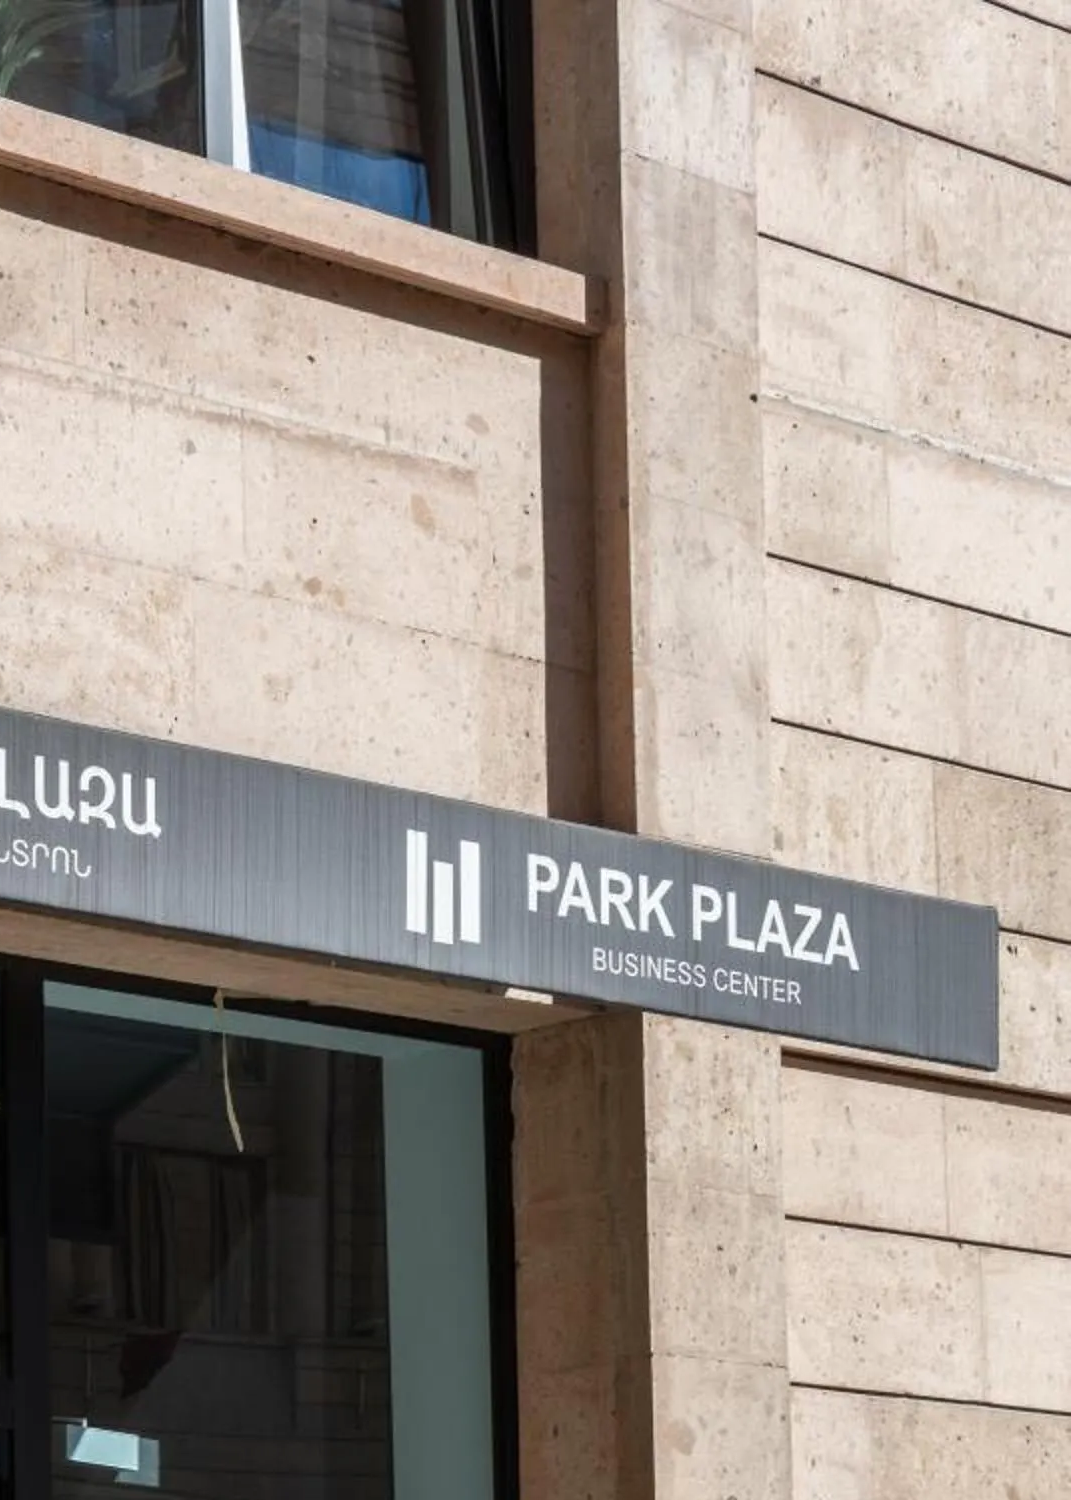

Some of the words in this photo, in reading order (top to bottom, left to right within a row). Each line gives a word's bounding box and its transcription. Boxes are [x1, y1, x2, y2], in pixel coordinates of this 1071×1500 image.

[527, 853, 676, 938] PARK
[691, 883, 860, 971] PLAZA
[592, 947, 707, 990] BUSINESS
[713, 967, 802, 1005] CENTER
